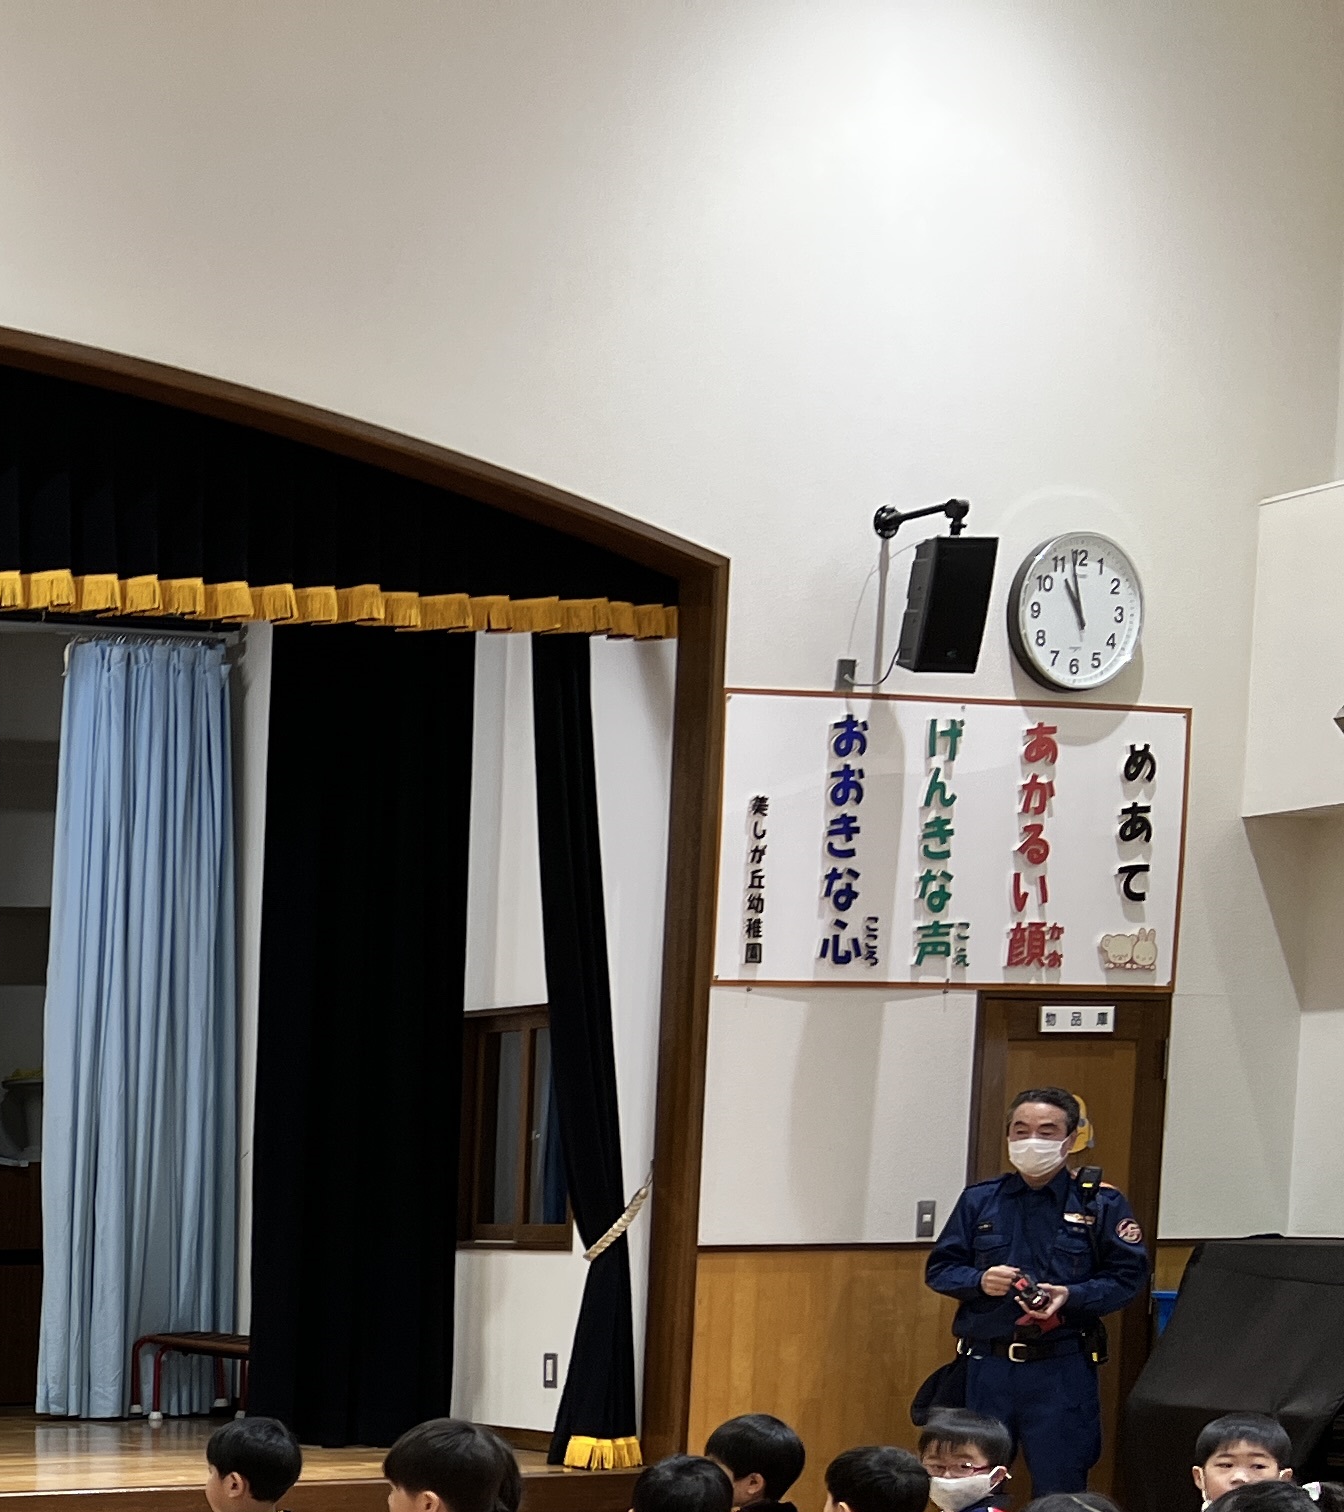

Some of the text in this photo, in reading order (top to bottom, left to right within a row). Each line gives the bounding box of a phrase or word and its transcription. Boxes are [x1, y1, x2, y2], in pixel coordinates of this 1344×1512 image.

[1052, 556, 1066, 573] 11
[1097, 557, 1104, 575] 1
[1036, 575, 1053, 592] 10
[1110, 578, 1121, 595] 2
[1030, 602, 1041, 618] 9
[1114, 606, 1124, 623] 3
[1035, 629, 1046, 646] 8
[1106, 633, 1116, 649] 4
[1050, 650, 1060, 666] 7
[1069, 658, 1079, 675] 6
[1091, 652, 1101, 668] 5
[1118, 743, 1157, 902] めあて
[819, 713, 869, 965] おおきな心
[914, 718, 965, 967] げんきな声
[1006, 722, 1058, 968] あかるい顔
